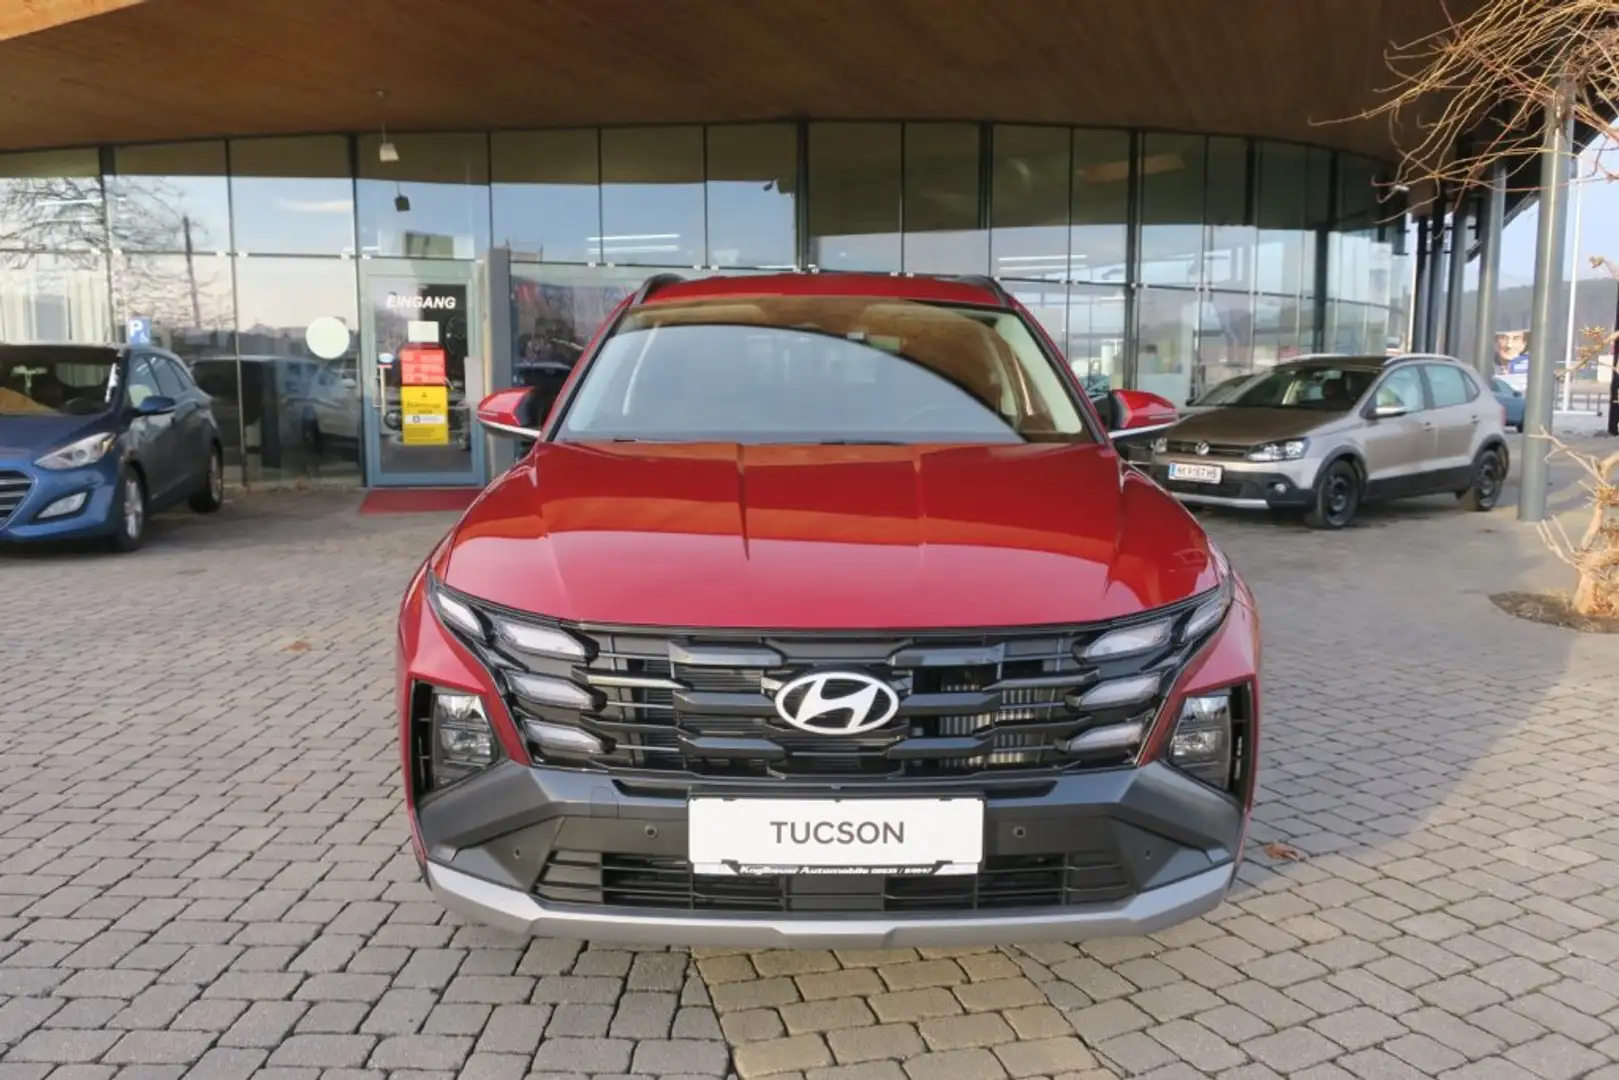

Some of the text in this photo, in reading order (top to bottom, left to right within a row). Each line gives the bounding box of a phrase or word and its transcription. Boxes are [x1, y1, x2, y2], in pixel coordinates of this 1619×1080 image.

[386, 296, 457, 310] EINGANG
[130, 320, 144, 337] P
[769, 820, 905, 845] TUCSON
